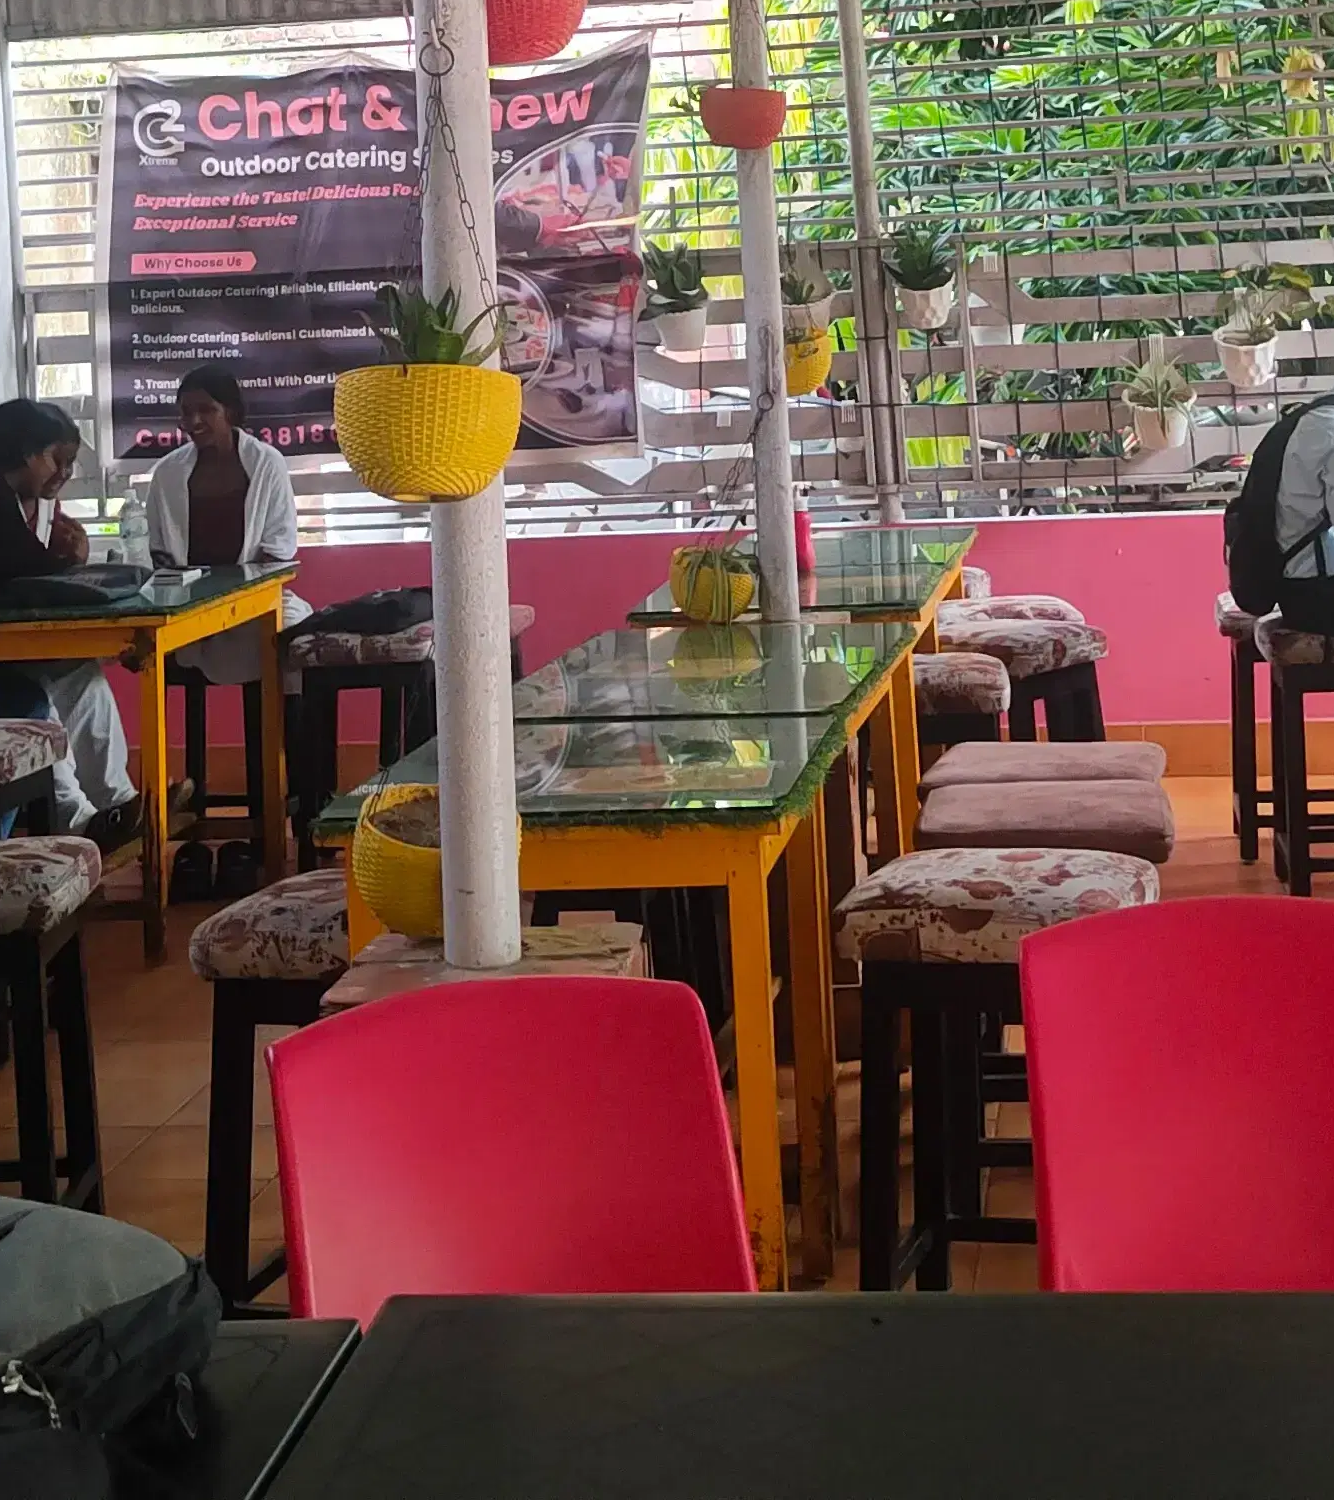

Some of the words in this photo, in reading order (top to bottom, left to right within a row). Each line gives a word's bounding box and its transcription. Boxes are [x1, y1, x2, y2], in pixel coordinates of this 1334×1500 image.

[198, 87, 347, 141] Chat
[362, 84, 408, 132] &
[201, 153, 300, 178] Outdoor
[304, 144, 407, 173] Catering
[134, 191, 233, 211] Experience
[232, 191, 259, 207] the
[262, 186, 312, 205] Taste!
[311, 183, 391, 201] Delicious
[132, 214, 236, 233] Exceptional
[236, 212, 299, 229] Service
[144, 257, 171, 272] Why
[174, 255, 223, 269] Choose
[226, 254, 243, 267] Us
[140, 288, 176, 301] Expert
[177, 287, 223, 298] Outdoor
[280, 282, 327, 295] Reliable,
[328, 280, 378, 292] Efficient,
[131, 303, 185, 315] Delicious.
[132, 333, 142, 344] 2.
[143, 332, 188, 344] Outdoor
[189, 330, 240, 346] Catering
[298, 325, 367, 339] Customized
[133, 347, 195, 362] Exceptional
[197, 346, 243, 359] Service.
[133, 379, 145, 390] 3.
[274, 374, 302, 388] With
[304, 373, 326, 385] Our
[134, 394, 158, 405] Cab
